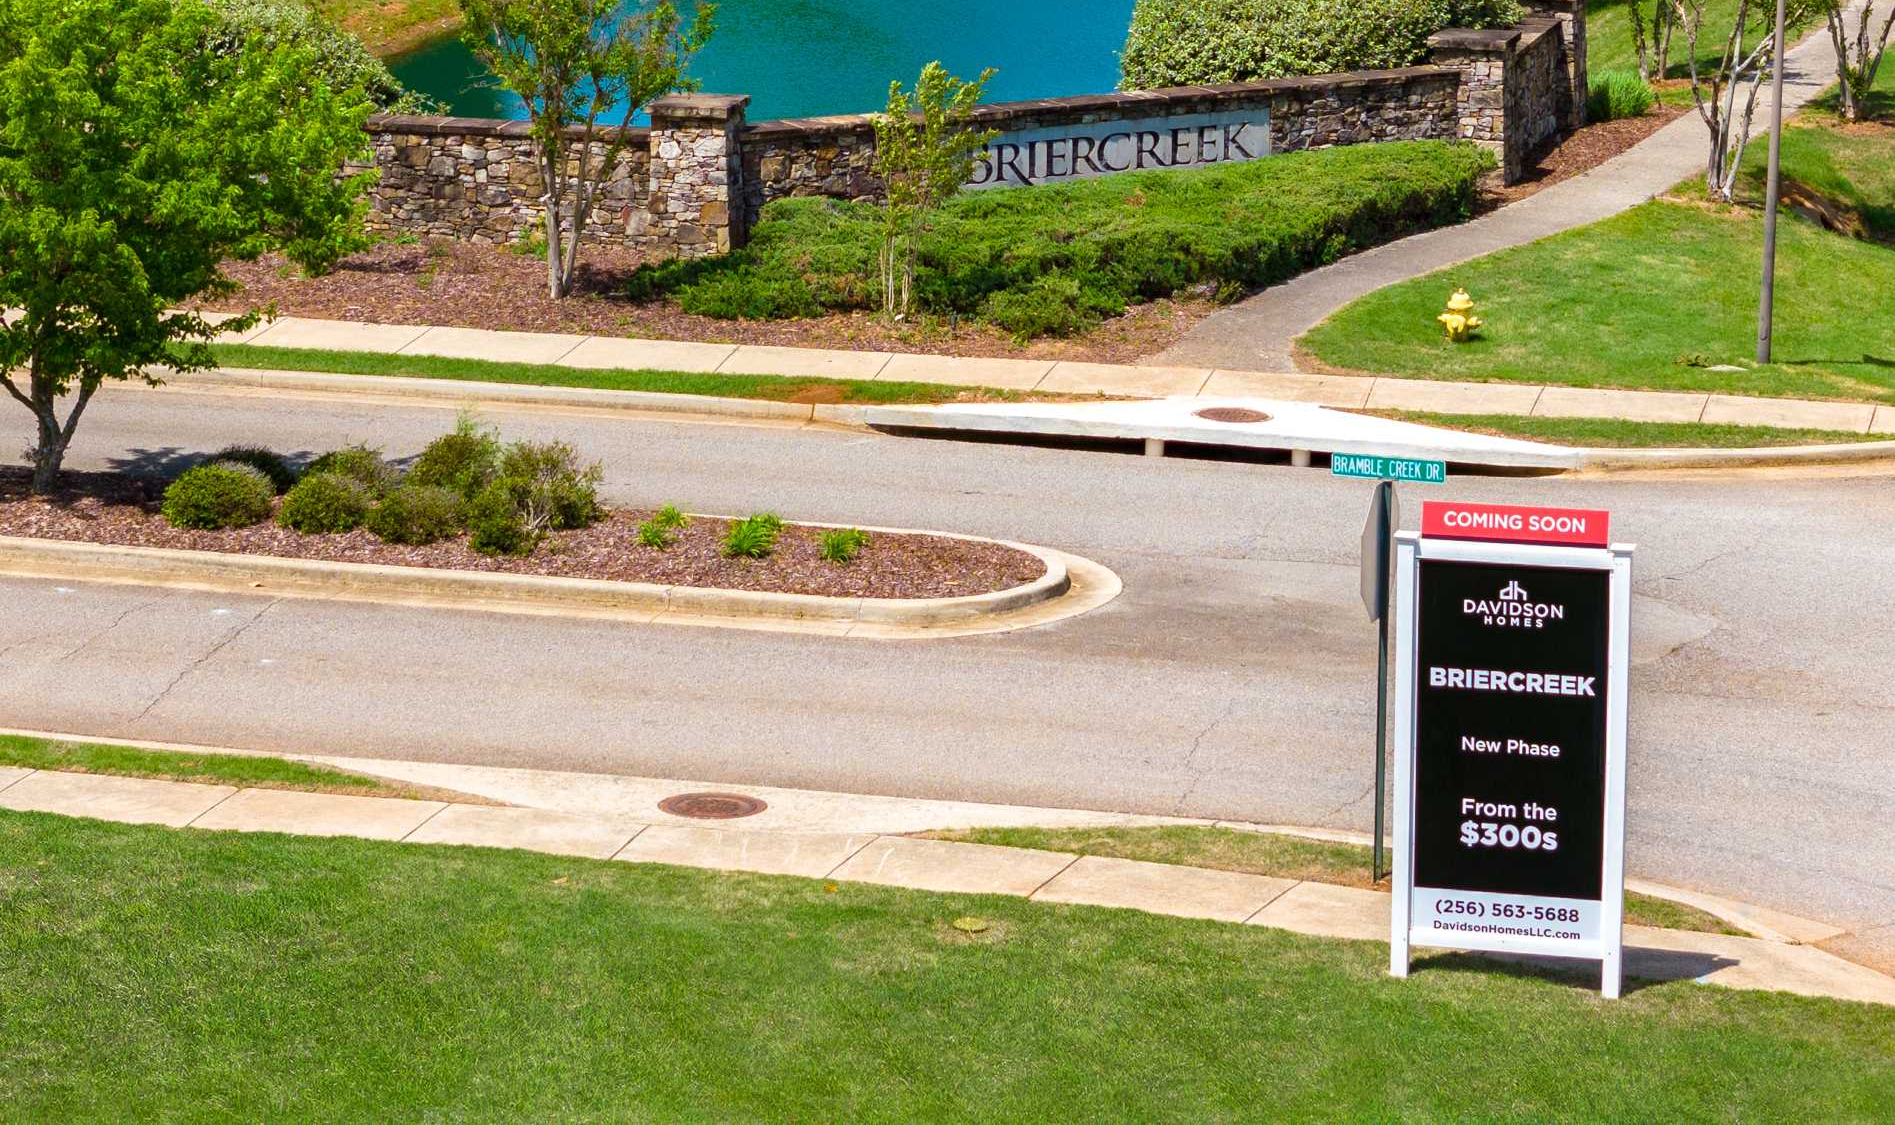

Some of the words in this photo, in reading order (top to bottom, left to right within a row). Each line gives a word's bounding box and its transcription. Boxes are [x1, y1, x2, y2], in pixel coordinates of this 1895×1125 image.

[1333, 455, 1382, 475] BRAMBLE
[1388, 459, 1421, 478] CREEK
[1425, 463, 1442, 480] DR.
[1443, 510, 1522, 530] COMING
[1528, 514, 1585, 533] SOON
[1463, 599, 1563, 618] DAVIDSON
[1483, 616, 1542, 628] HOMES
[1429, 667, 1595, 696] BRIERCREEK
[1461, 736, 1500, 752] New
[1507, 739, 1559, 756] Phase
[1461, 798, 1516, 817] From
[1523, 803, 1556, 820] the
[1459, 820, 1557, 850] $300s
[1435, 899, 1484, 917] (256)
[1491, 903, 1579, 922] 563-5688
[1433, 919, 1580, 939] DavidsonHomesLLC.com
